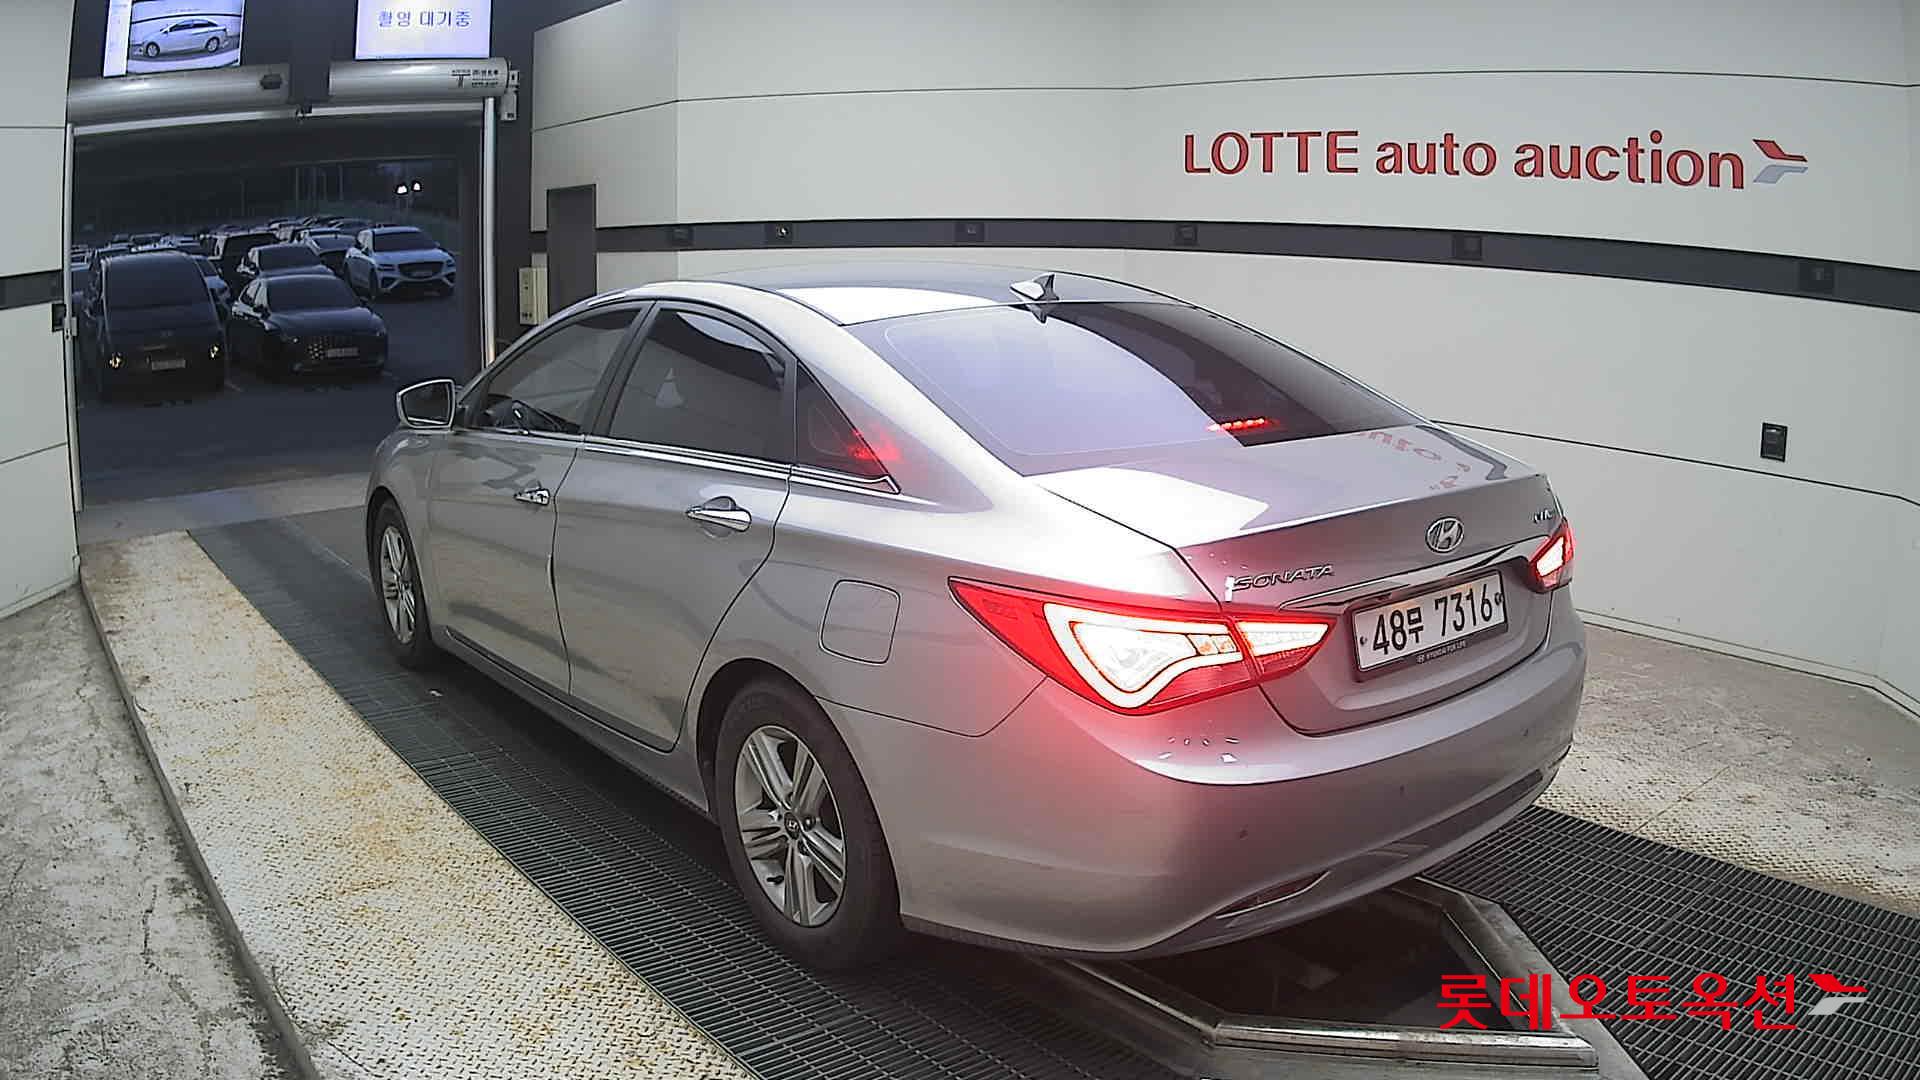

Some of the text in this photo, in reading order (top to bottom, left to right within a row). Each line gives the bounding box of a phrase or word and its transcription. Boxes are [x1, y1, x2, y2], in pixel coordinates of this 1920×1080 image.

[1185, 130, 1746, 190] LOTTE auto auction
[1231, 564, 1336, 592] SONATA
[1373, 609, 1424, 655] 48무
[1434, 583, 1493, 637] 7316
